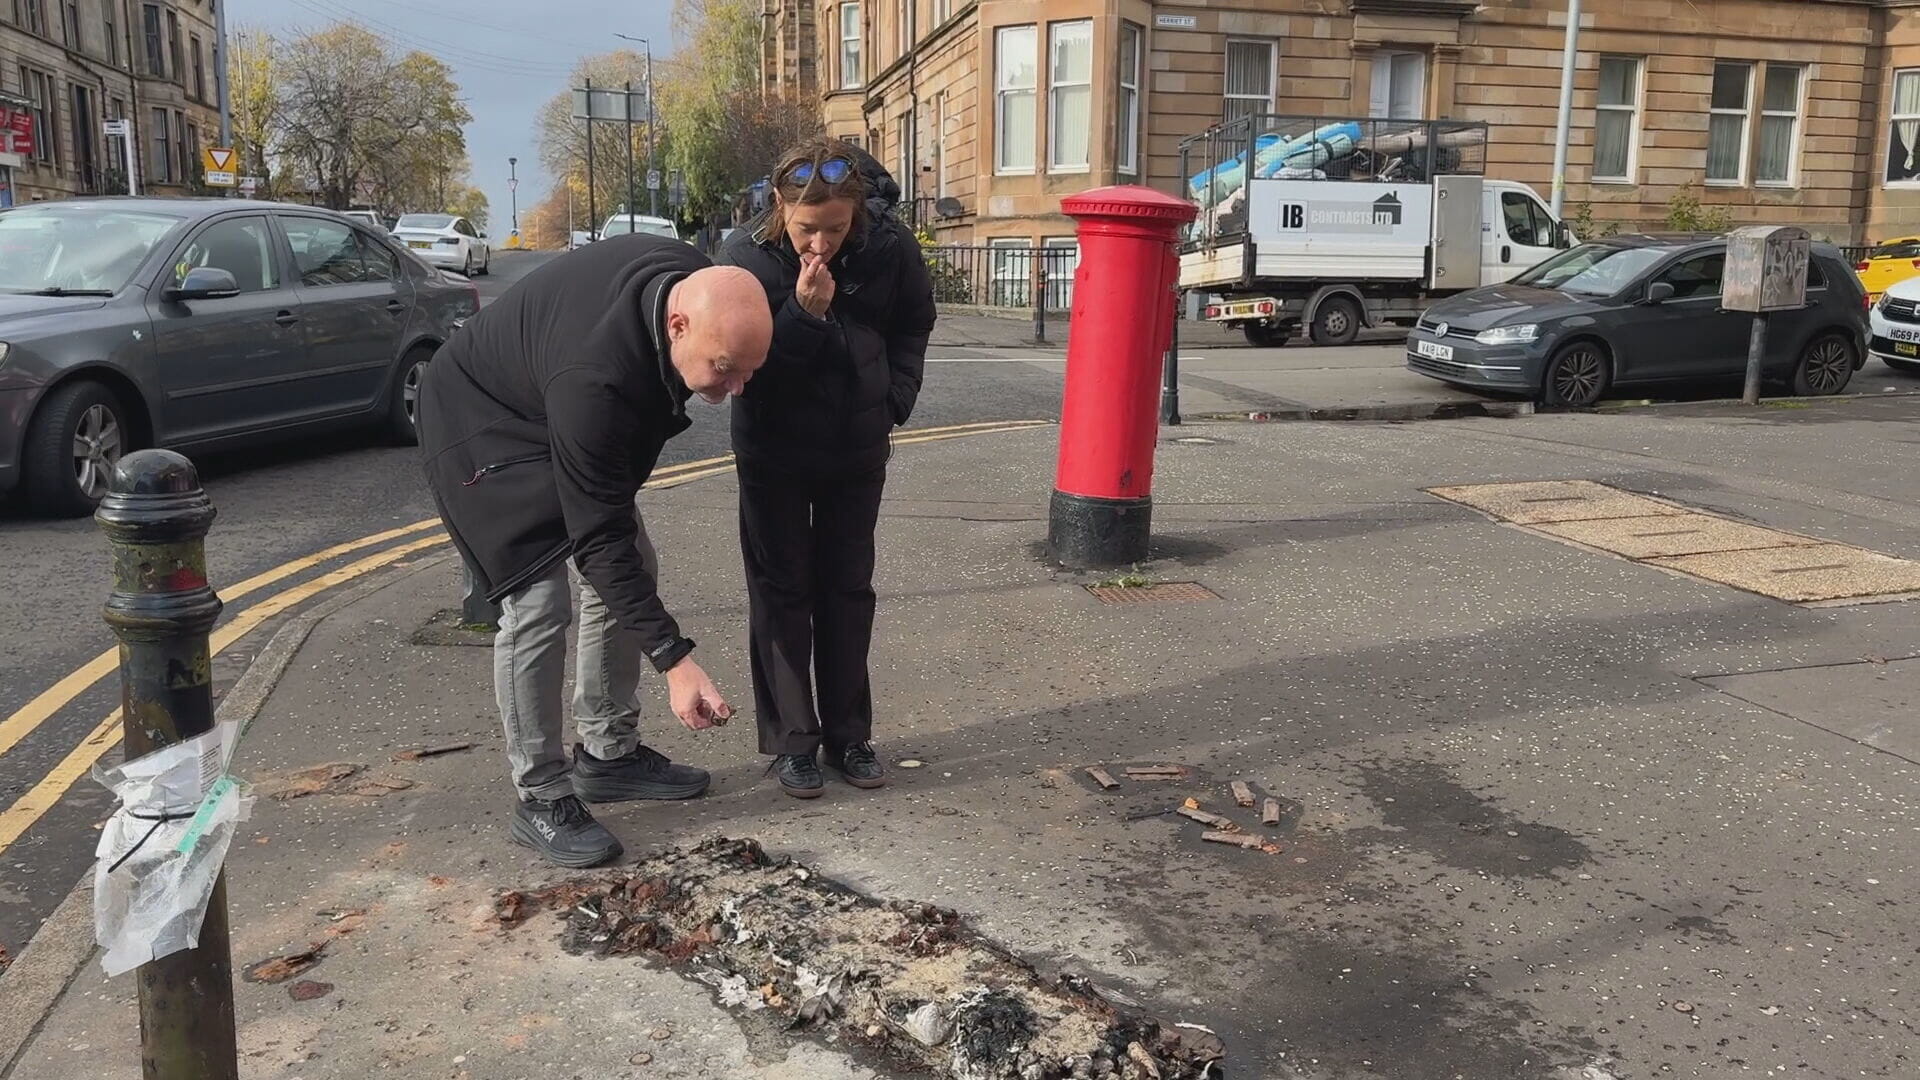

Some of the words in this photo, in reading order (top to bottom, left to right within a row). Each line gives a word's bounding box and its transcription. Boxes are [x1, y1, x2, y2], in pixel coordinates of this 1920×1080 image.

[1283, 204, 1303, 228] IB
[1311, 210, 1372, 225] CONTRACTS
[1375, 211, 1393, 225] LTD
[1890, 328, 1912, 340] HG69
[531, 814, 556, 843] HOKA
